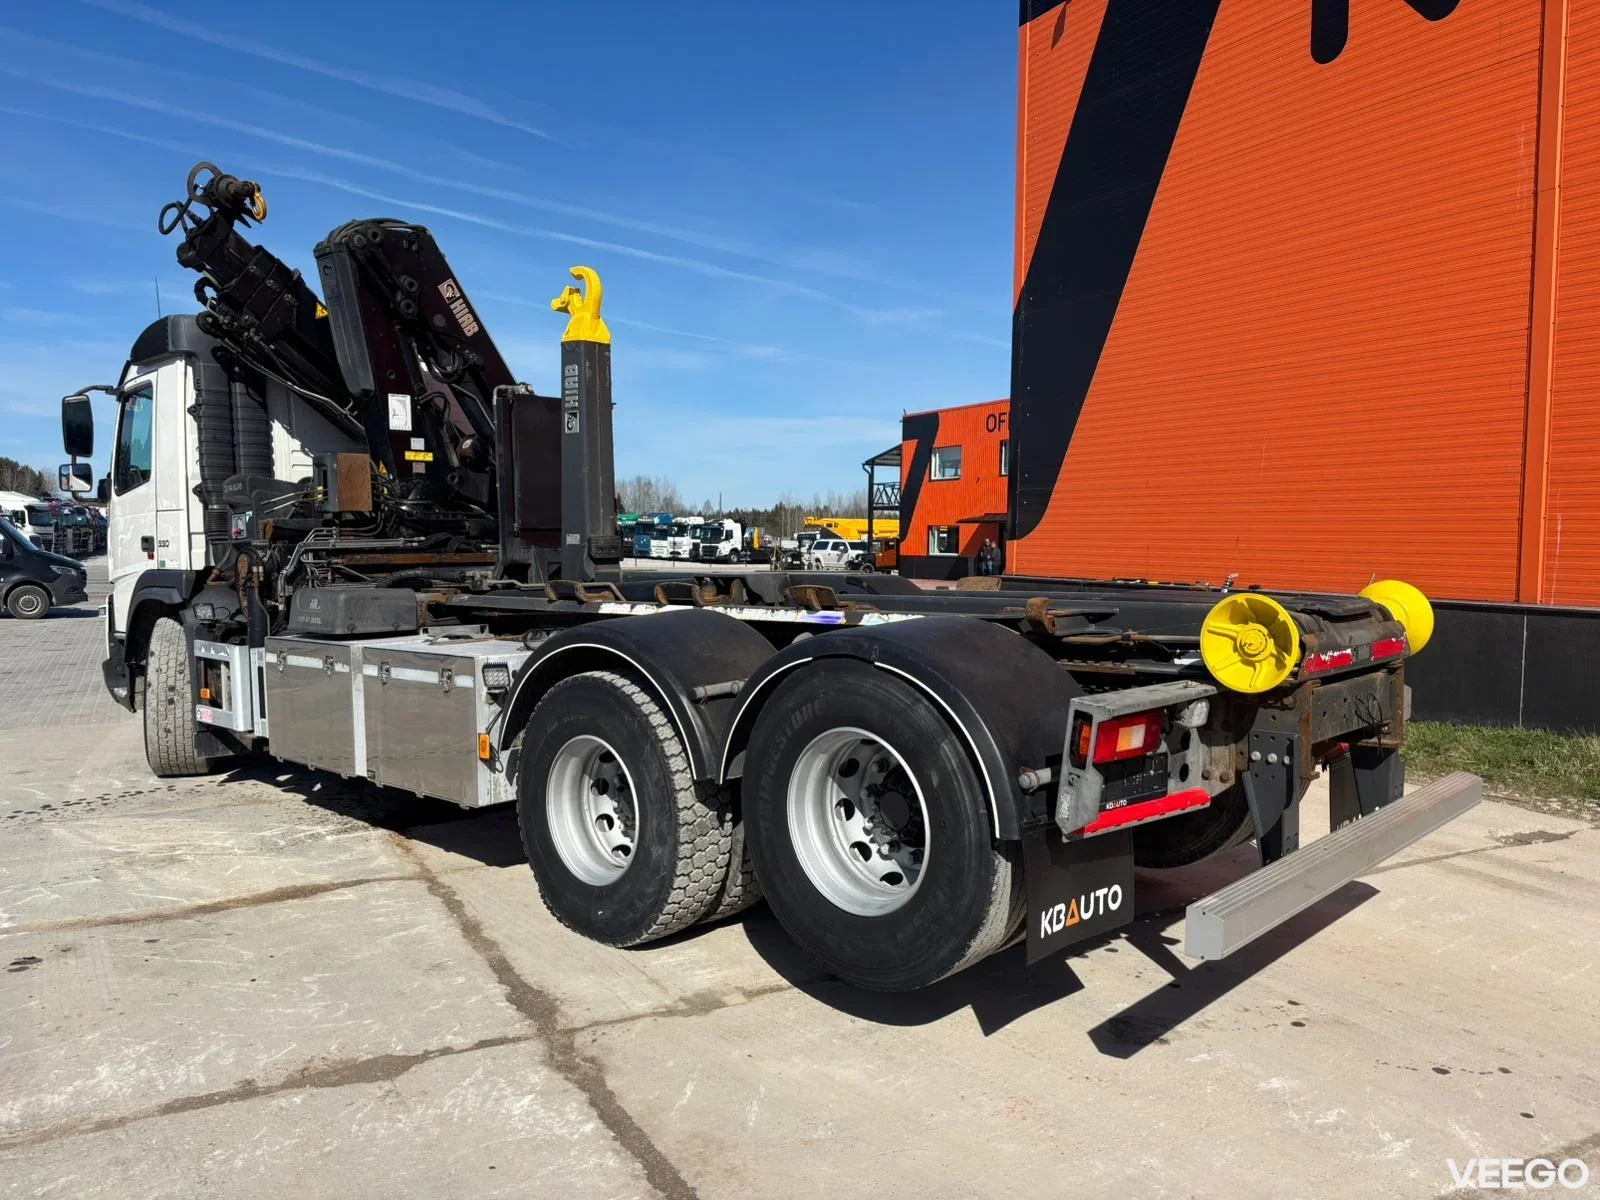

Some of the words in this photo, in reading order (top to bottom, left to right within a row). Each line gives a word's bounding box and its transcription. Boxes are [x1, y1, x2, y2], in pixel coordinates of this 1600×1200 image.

[449, 298, 479, 337] HIAB
[564, 364, 579, 408] HIAB
[986, 412, 1010, 432] OF
[1040, 884, 1123, 939] KBAUTO
